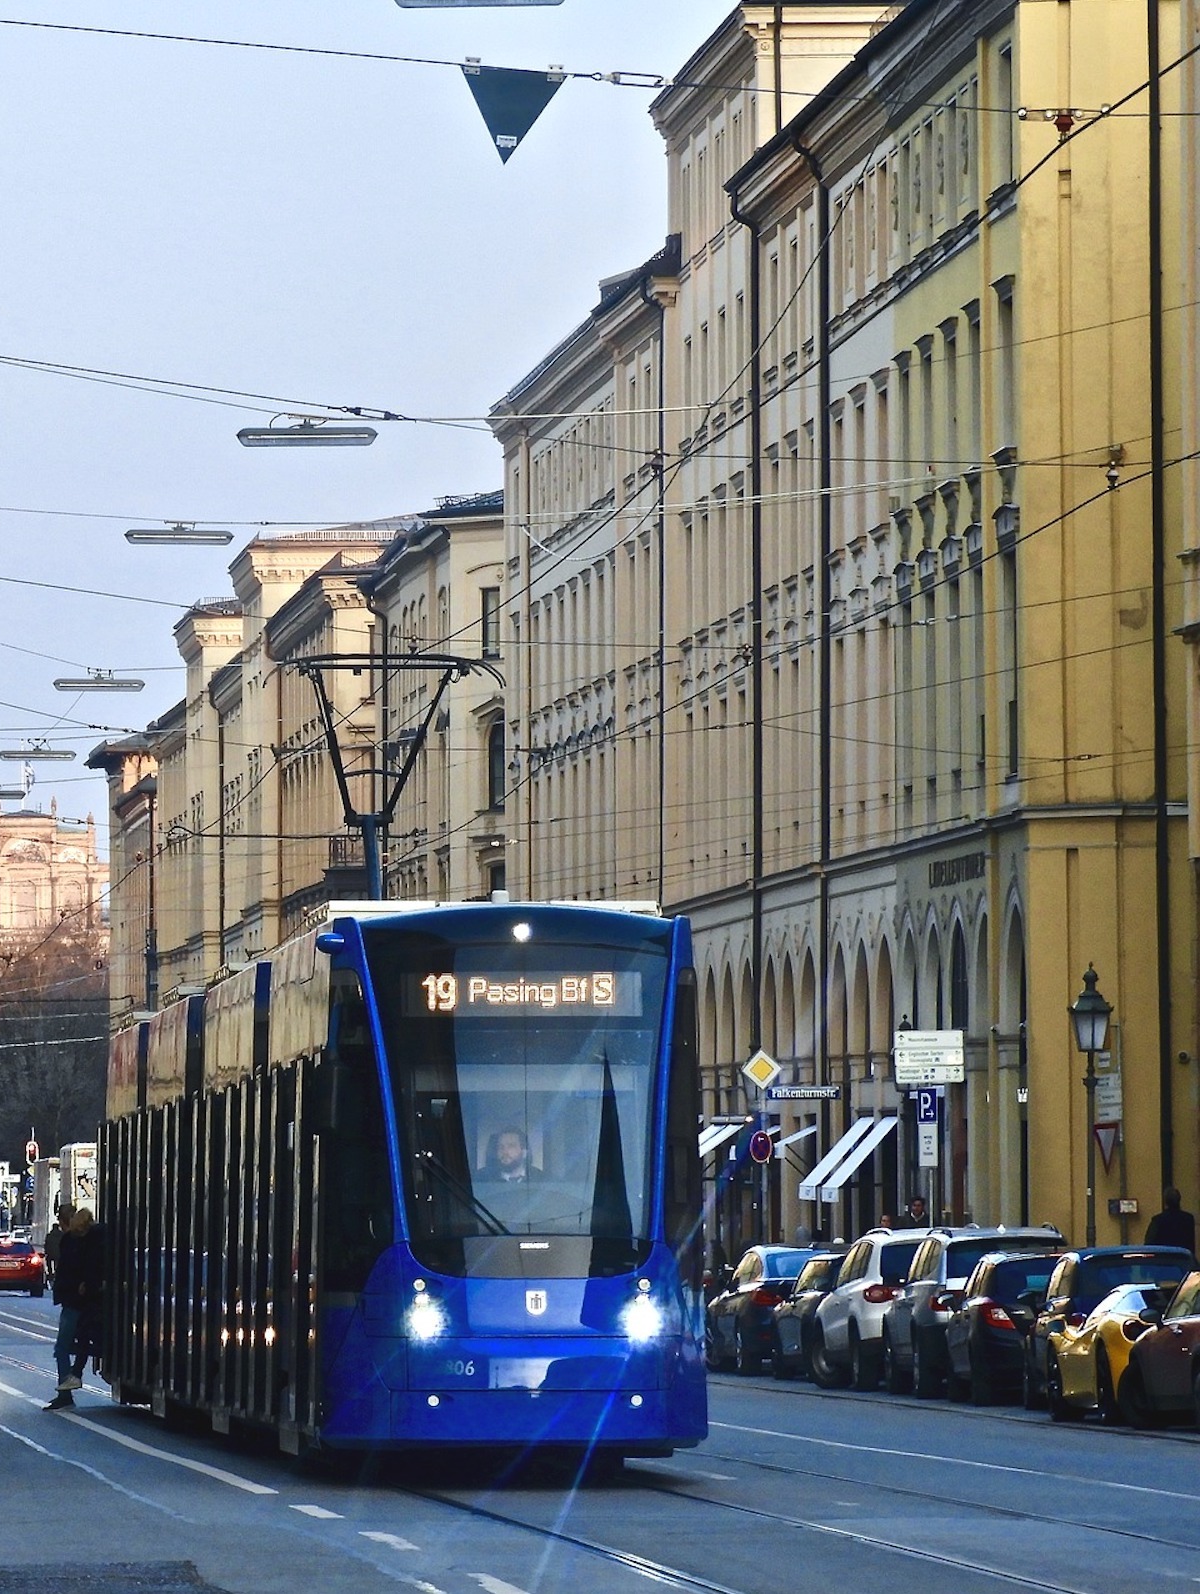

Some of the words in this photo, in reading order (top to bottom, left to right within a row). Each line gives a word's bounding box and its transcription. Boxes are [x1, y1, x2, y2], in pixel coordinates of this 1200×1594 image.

[422, 974, 457, 1011] 19
[469, 976, 557, 1007] Pasing
[561, 977, 588, 1002] Bf
[921, 1093, 931, 1119] P
